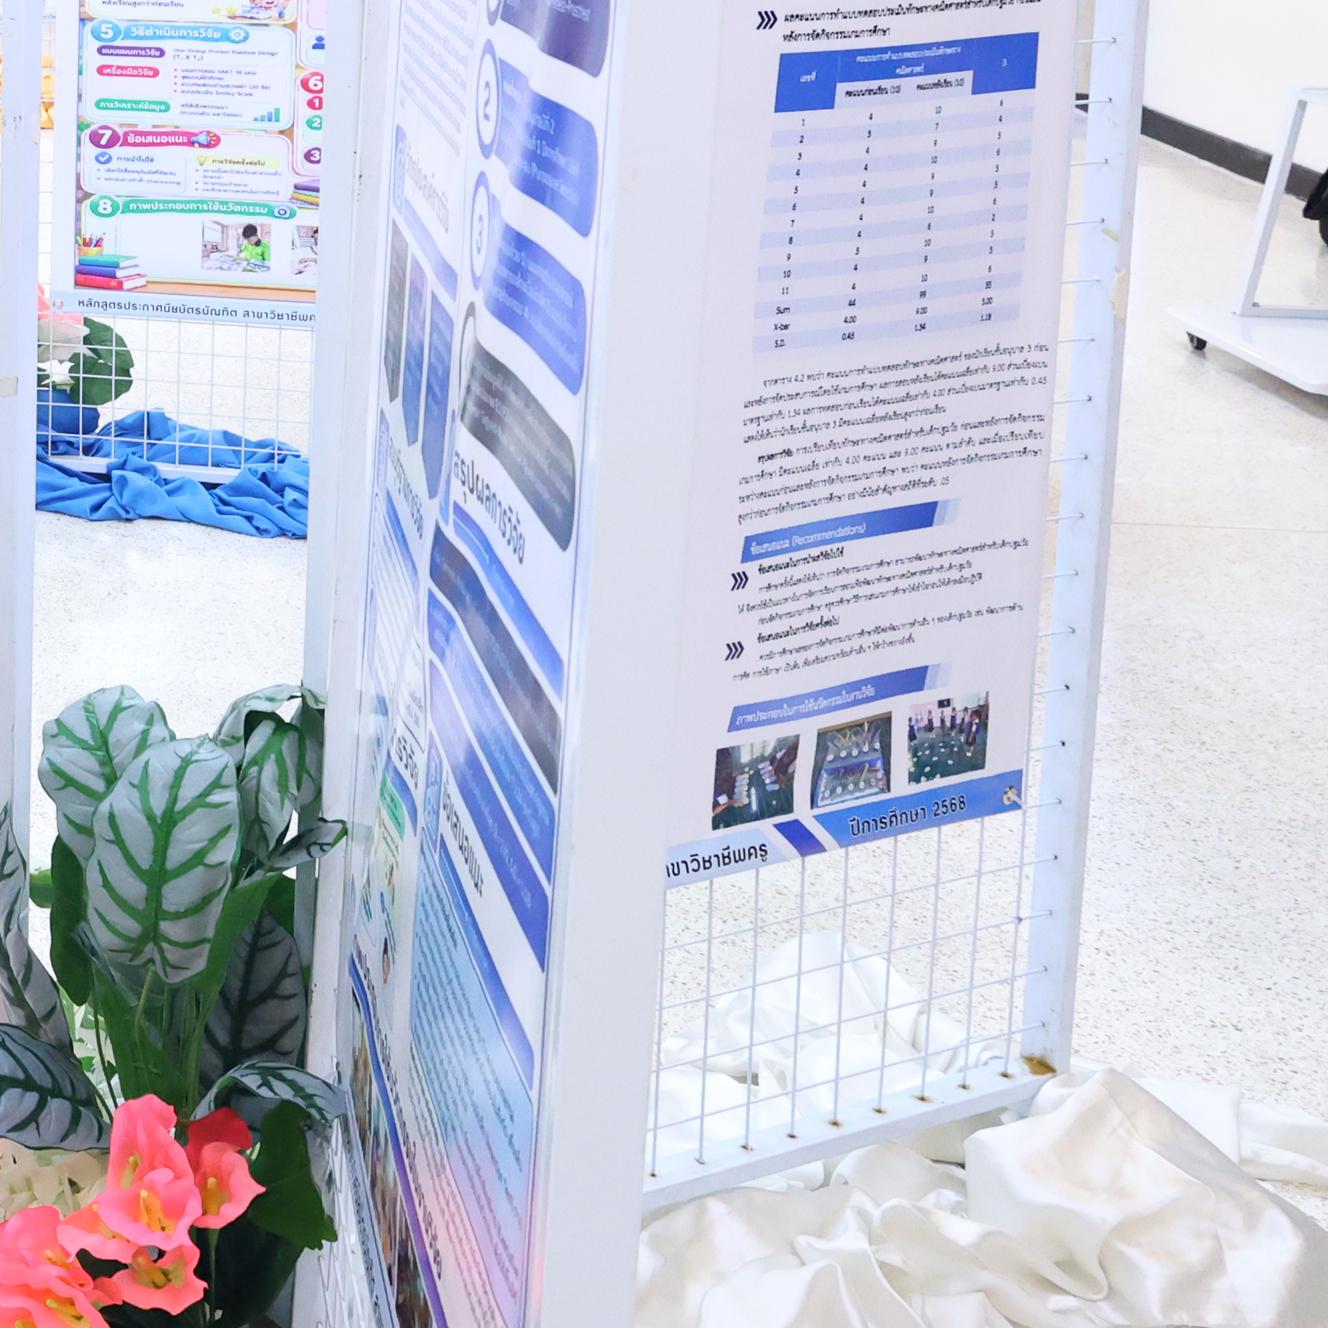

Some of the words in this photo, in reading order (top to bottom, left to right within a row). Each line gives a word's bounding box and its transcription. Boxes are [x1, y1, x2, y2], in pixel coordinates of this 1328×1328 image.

[101, 23, 114, 38] 5
[131, 23, 222, 39] วิธีดำเนินการวิจัย
[101, 46, 161, 57] แบบแผนการวิจัย
[308, 77, 324, 91] 6
[312, 118, 321, 128] 2
[97, 129, 112, 145] 7
[127, 133, 188, 145] ข้อเสนอแนะ
[97, 199, 113, 214] 8
[129, 200, 268, 214] ภาพประกอบการใช้นวัตกรรม
[78, 298, 238, 318] หลักสูตรประกาศนียบัตรบัณฑิต
[242, 306, 316, 322] สาขาวิชาชีพค
[776, 306, 790, 314] Sum
[665, 840, 769, 878] ขาวิชาชีพครู
[850, 807, 927, 838] ปีการศึกษา
[933, 795, 967, 817] 2568
